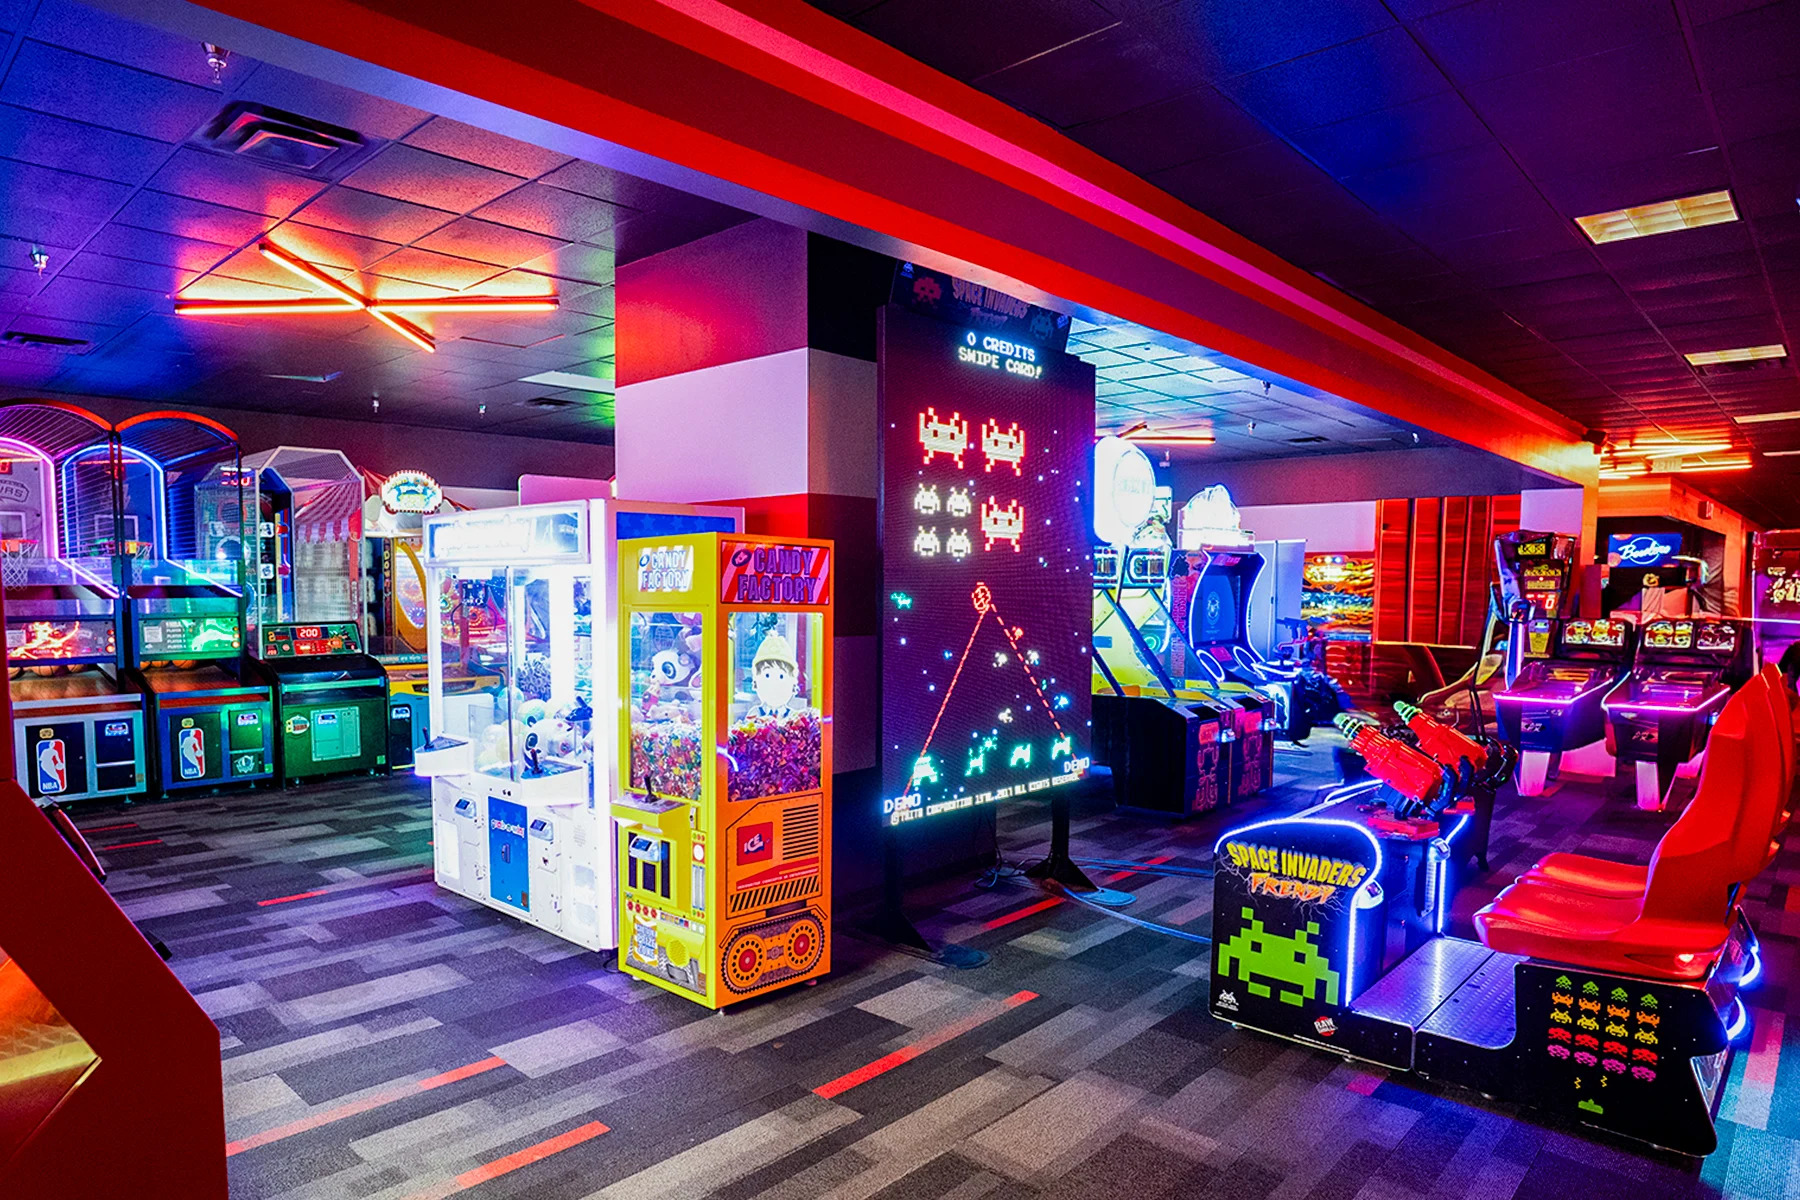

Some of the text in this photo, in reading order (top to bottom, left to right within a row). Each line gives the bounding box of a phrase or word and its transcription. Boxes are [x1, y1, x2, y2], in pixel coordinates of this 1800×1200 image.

[967, 332, 1036, 362] 0 CREDITS
[958, 346, 1043, 379] SWIPE CARD!
[651, 550, 686, 569] CANDY
[753, 547, 813, 575] CANDY
[641, 569, 690, 590] FACTORY
[737, 574, 816, 602] FACTORY
[299, 628, 318, 638] 200
[1064, 757, 1090, 773] DEMO
[42, 781, 58, 790] NBA
[884, 793, 921, 814] DEMO
[744, 833, 765, 854] ICE
[1226, 840, 1367, 888] SPACE INVADERS
[1250, 872, 1337, 904] FRENZY
[1314, 1018, 1336, 1033] RAW
